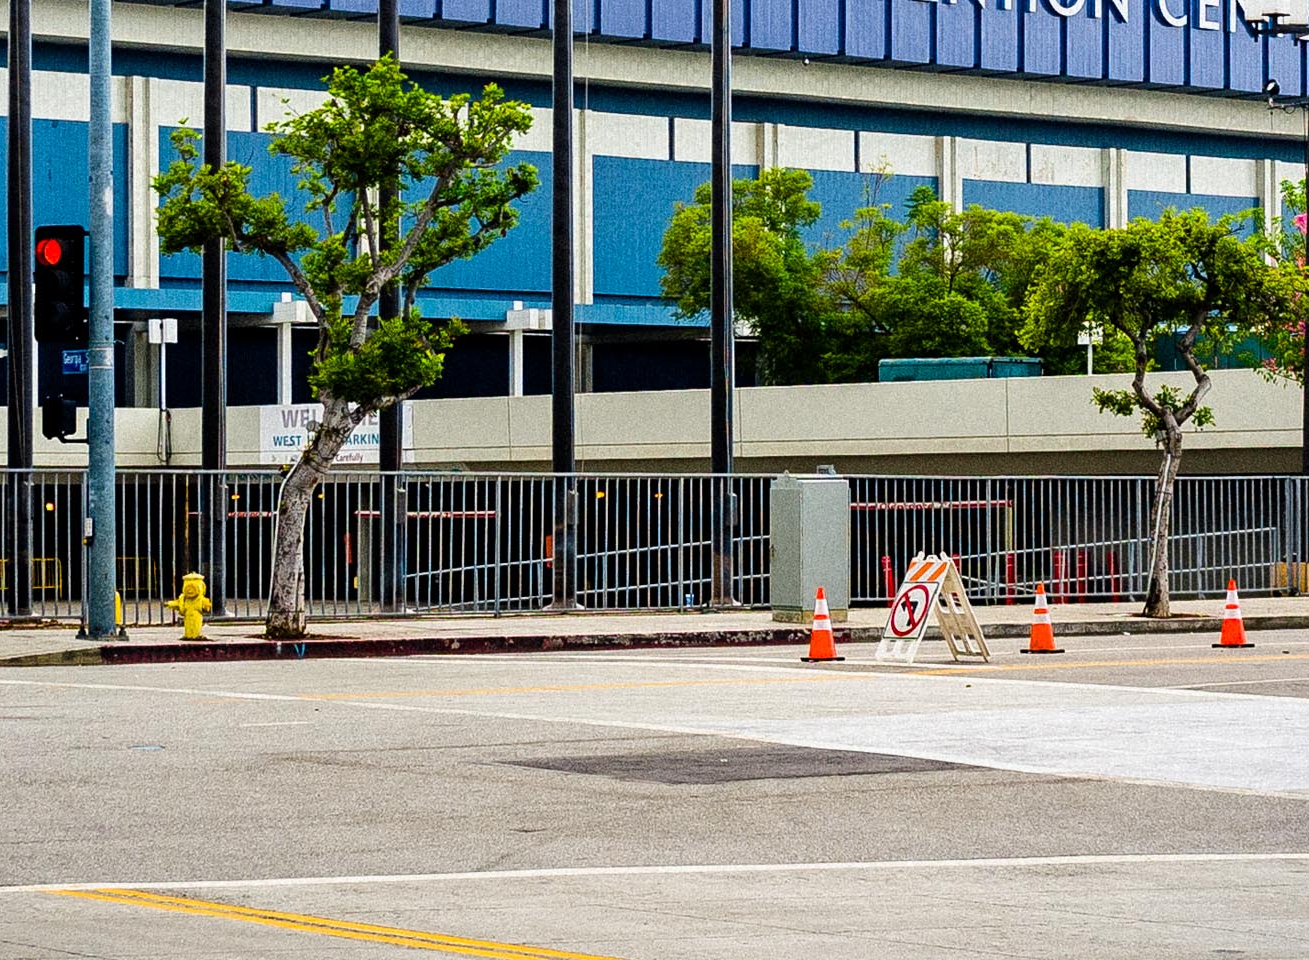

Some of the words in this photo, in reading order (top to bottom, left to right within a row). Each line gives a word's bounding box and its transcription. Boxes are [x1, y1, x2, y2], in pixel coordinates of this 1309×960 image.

[281, 408, 379, 428] WELE
[273, 435, 301, 446] WEST
[345, 433, 380, 445] ARKIN
[335, 453, 363, 463] Carefully
